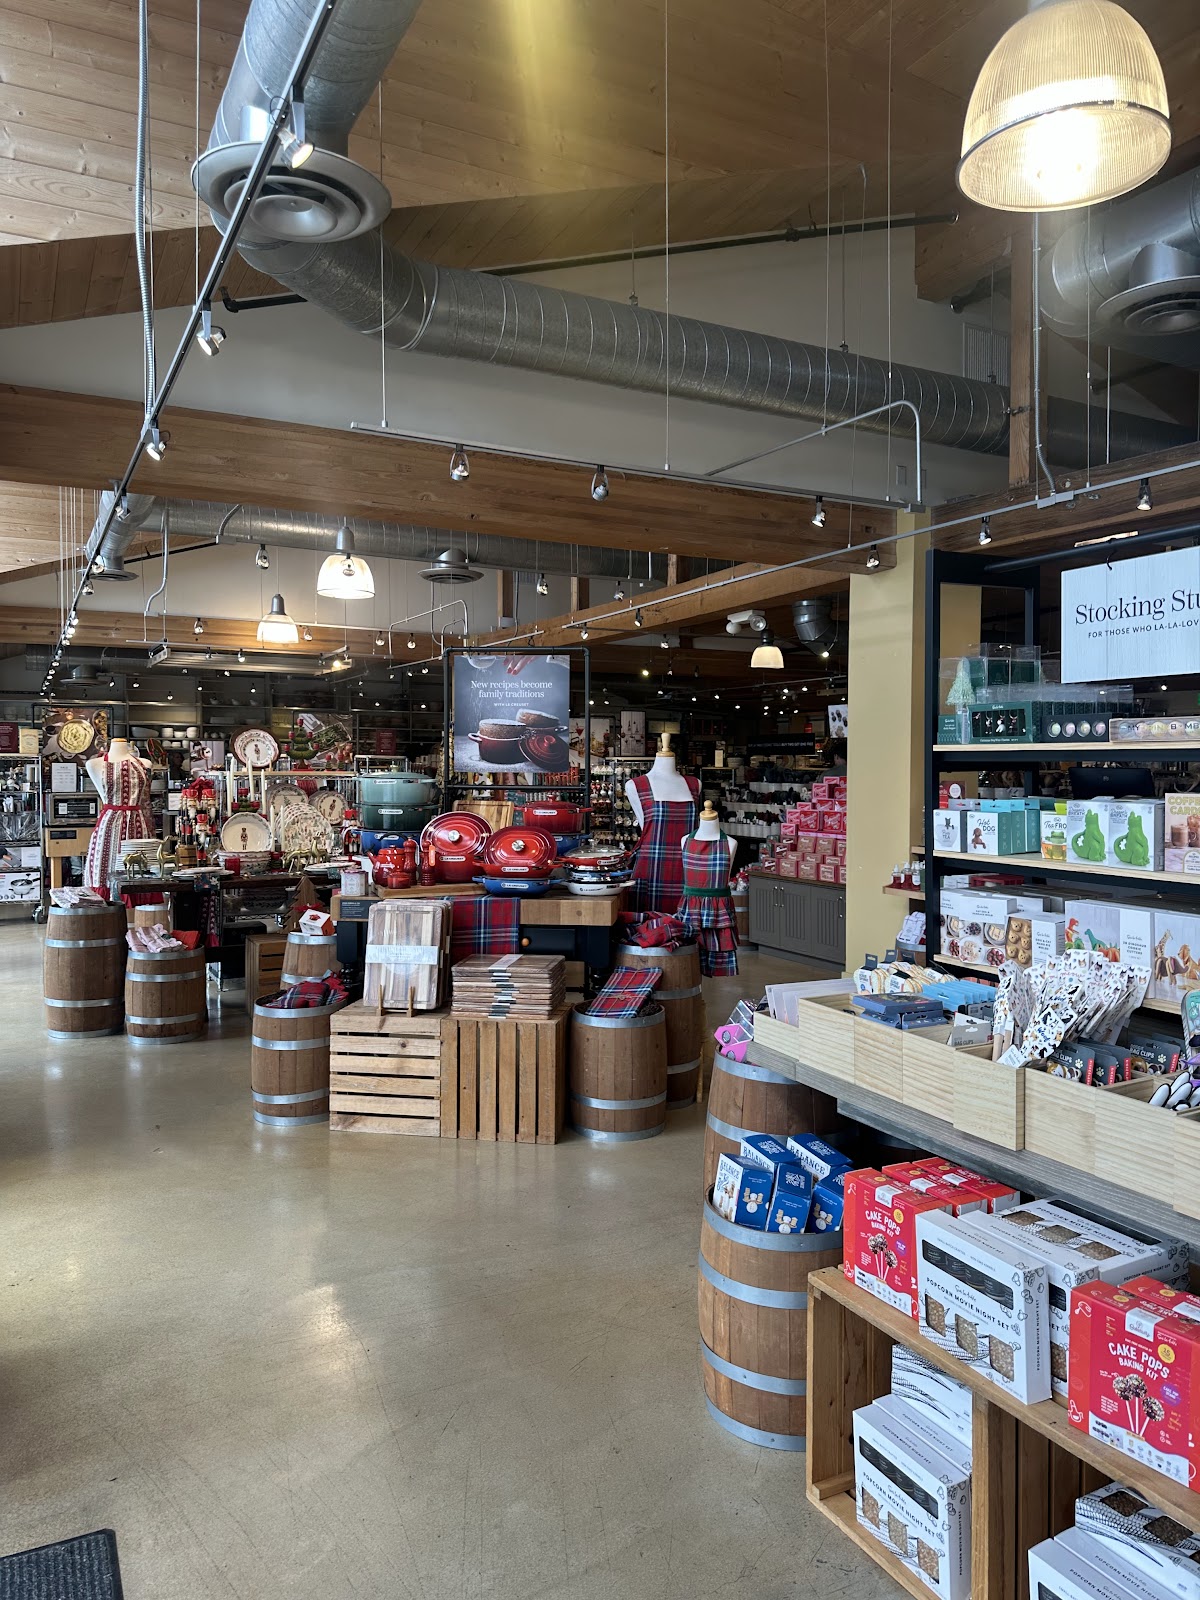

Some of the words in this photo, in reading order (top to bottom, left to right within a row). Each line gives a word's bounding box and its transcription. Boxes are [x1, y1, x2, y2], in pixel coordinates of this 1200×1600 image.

[1075, 595, 1166, 626] Stocking
[1088, 631, 1103, 639] FOR
[1105, 627, 1130, 637] THOSE
[1132, 625, 1152, 633] WHO
[470, 680, 489, 689] New
[490, 680, 520, 692] recipes
[520, 680, 553, 689] become
[478, 689, 504, 700] family
[505, 689, 545, 698] traditions
[1059, 1053, 1073, 1063] CLIPS
[1140, 1050, 1155, 1058] CLIPS
[720, 1160, 740, 1180] BALANCE
[790, 1145, 826, 1175] BALANCE
[864, 1210, 882, 1223] CAKE
[883, 1215, 901, 1236] POPS
[870, 1221, 887, 1232] BAKING
[886, 1228, 895, 1238] KIT
[1036, 1206, 1067, 1220] POPCORN
[1068, 1219, 1092, 1231] MOVIE
[1092, 1229, 1116, 1241] NIGHT
[1117, 1240, 1132, 1248] SET
[926, 1277, 952, 1297] POPCORN
[954, 1293, 973, 1310] MOVIE
[975, 1306, 994, 1323] NIGHT
[997, 1319, 1009, 1331] SET
[1049, 1322, 1060, 1331] ET
[1108, 1342, 1137, 1360] CAKE
[1141, 1351, 1170, 1379] POPS
[1118, 1357, 1144, 1373] BAKING
[1145, 1368, 1159, 1381] KIT
[902, 1412, 919, 1427] POPCORN
[920, 1425, 932, 1437] MOVIE
[882, 1423, 898, 1439] POPCORN
[899, 1437, 911, 1449] MOVIE
[923, 1456, 931, 1465] SET
[863, 1472, 886, 1495] POPCORN
[887, 1494, 904, 1511] MOVIE
[905, 1509, 922, 1527] NIGHT
[924, 1525, 934, 1538] SET
[1069, 1568, 1095, 1589] POPCORN
[1094, 1555, 1121, 1575] POPCORN
[1121, 1574, 1141, 1588] MOVIE
